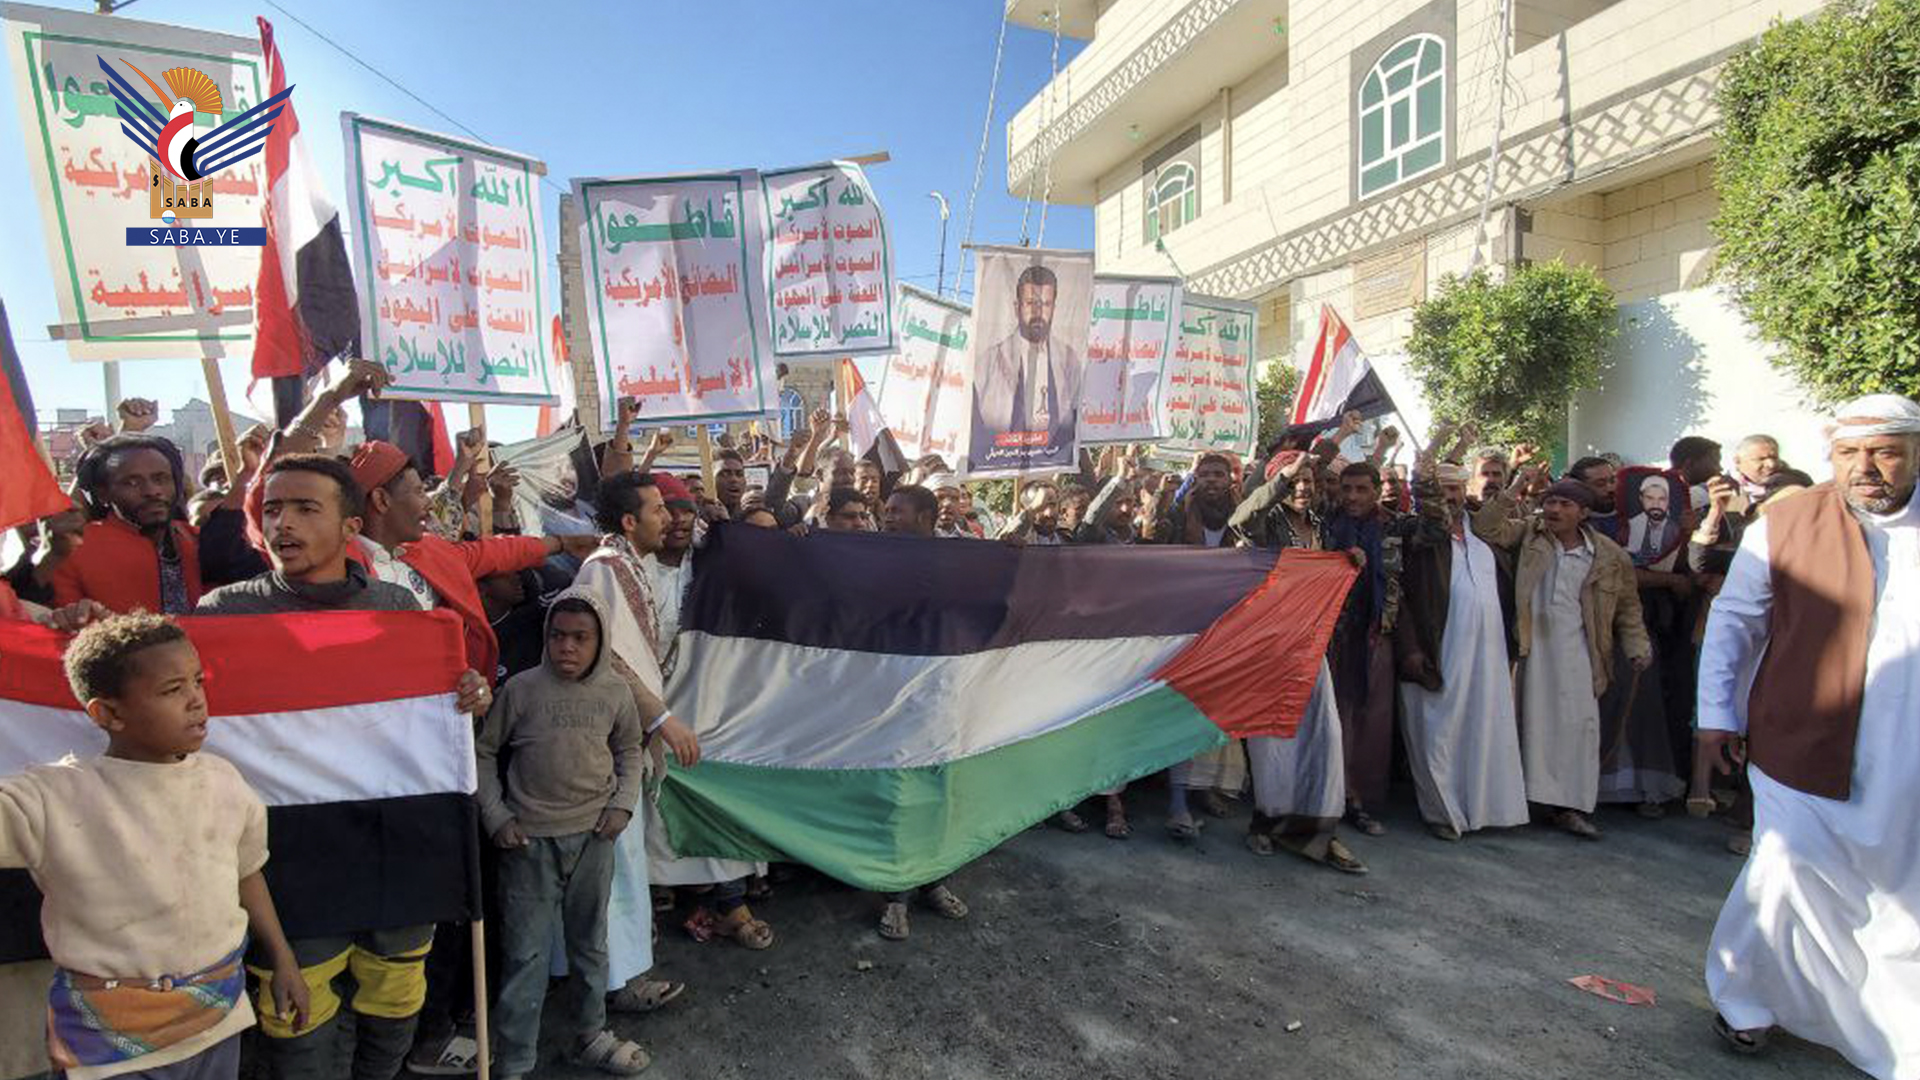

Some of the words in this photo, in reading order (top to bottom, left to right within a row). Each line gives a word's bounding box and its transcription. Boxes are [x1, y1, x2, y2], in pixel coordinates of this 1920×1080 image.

[470, 165, 524, 207] الله
[595, 196, 736, 254] قاطعوا
[838, 311, 885, 345] النصر
[1218, 318, 1248, 342] الله
[475, 342, 538, 385] النصر
